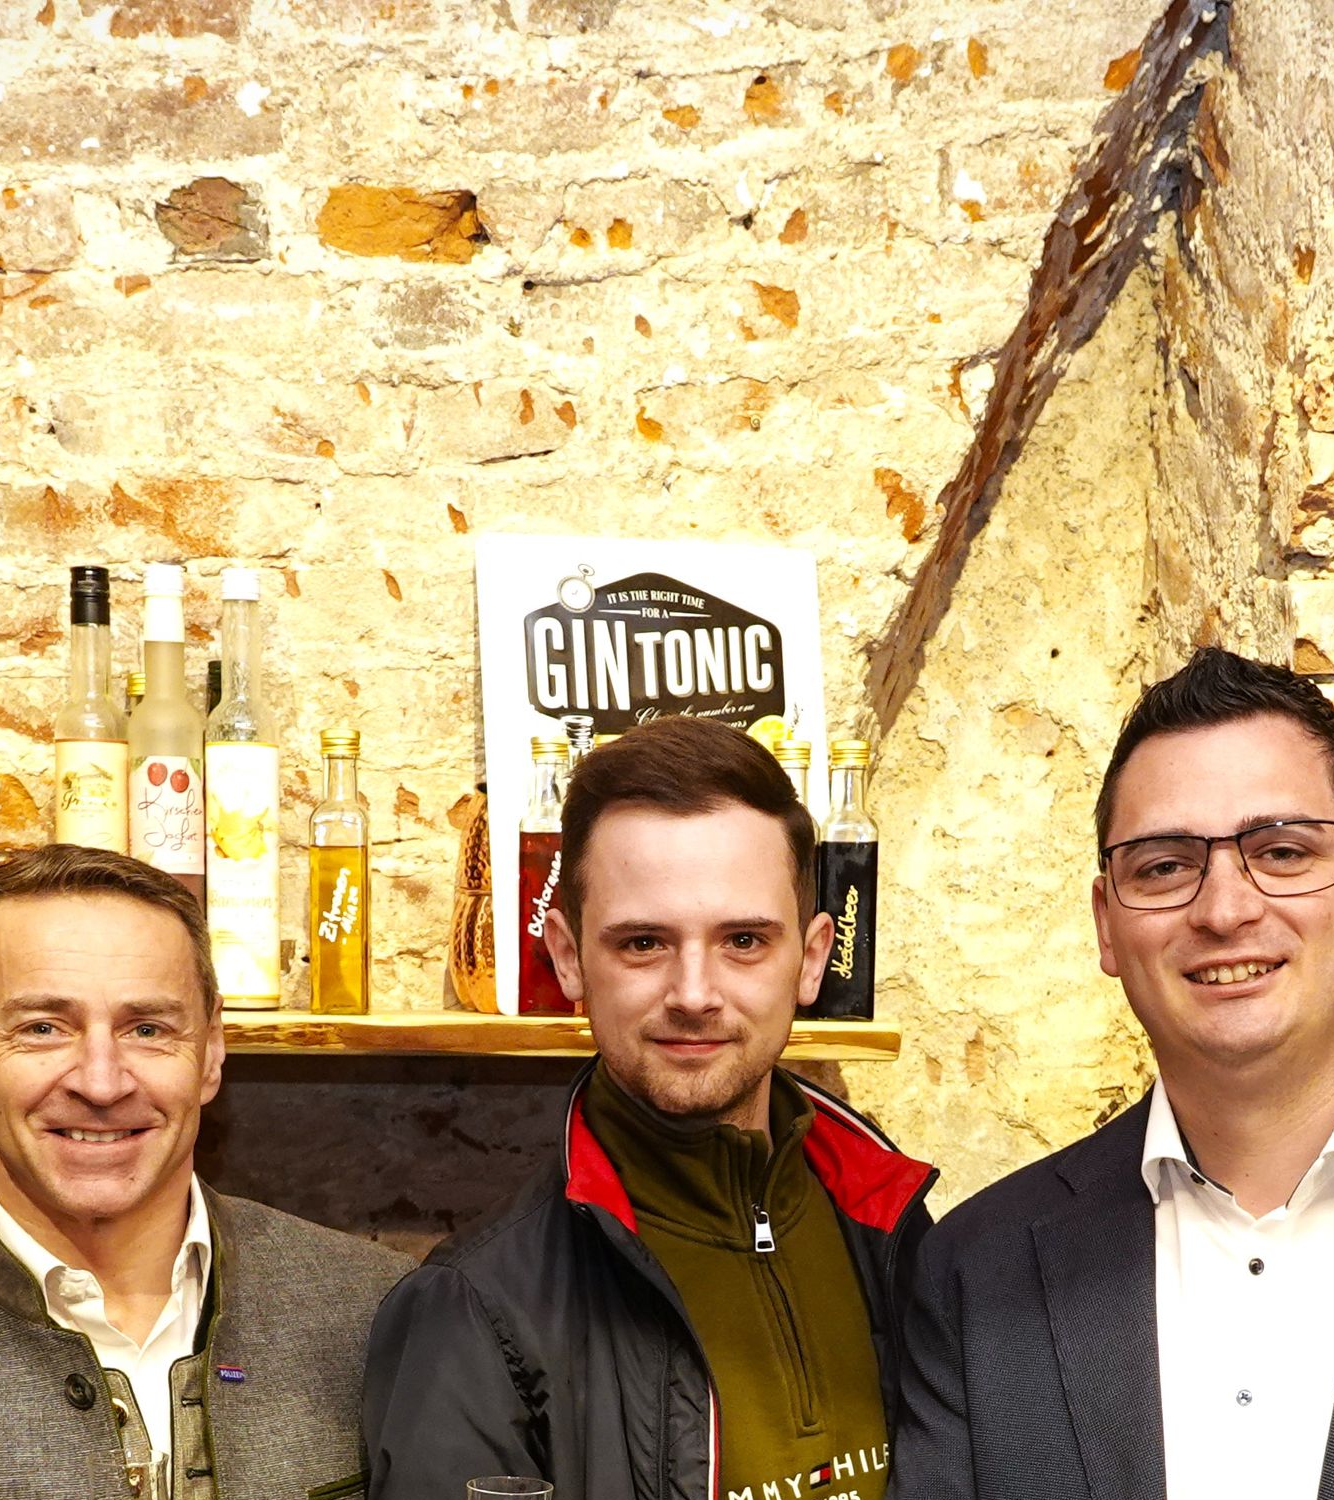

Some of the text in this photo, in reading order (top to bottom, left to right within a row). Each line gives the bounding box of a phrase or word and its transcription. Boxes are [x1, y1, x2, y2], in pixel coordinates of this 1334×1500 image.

[607, 589, 706, 610] IT IS THE RIGHT TIME
[641, 607, 670, 619] FOR A
[532, 615, 775, 711] GIN TONIC
